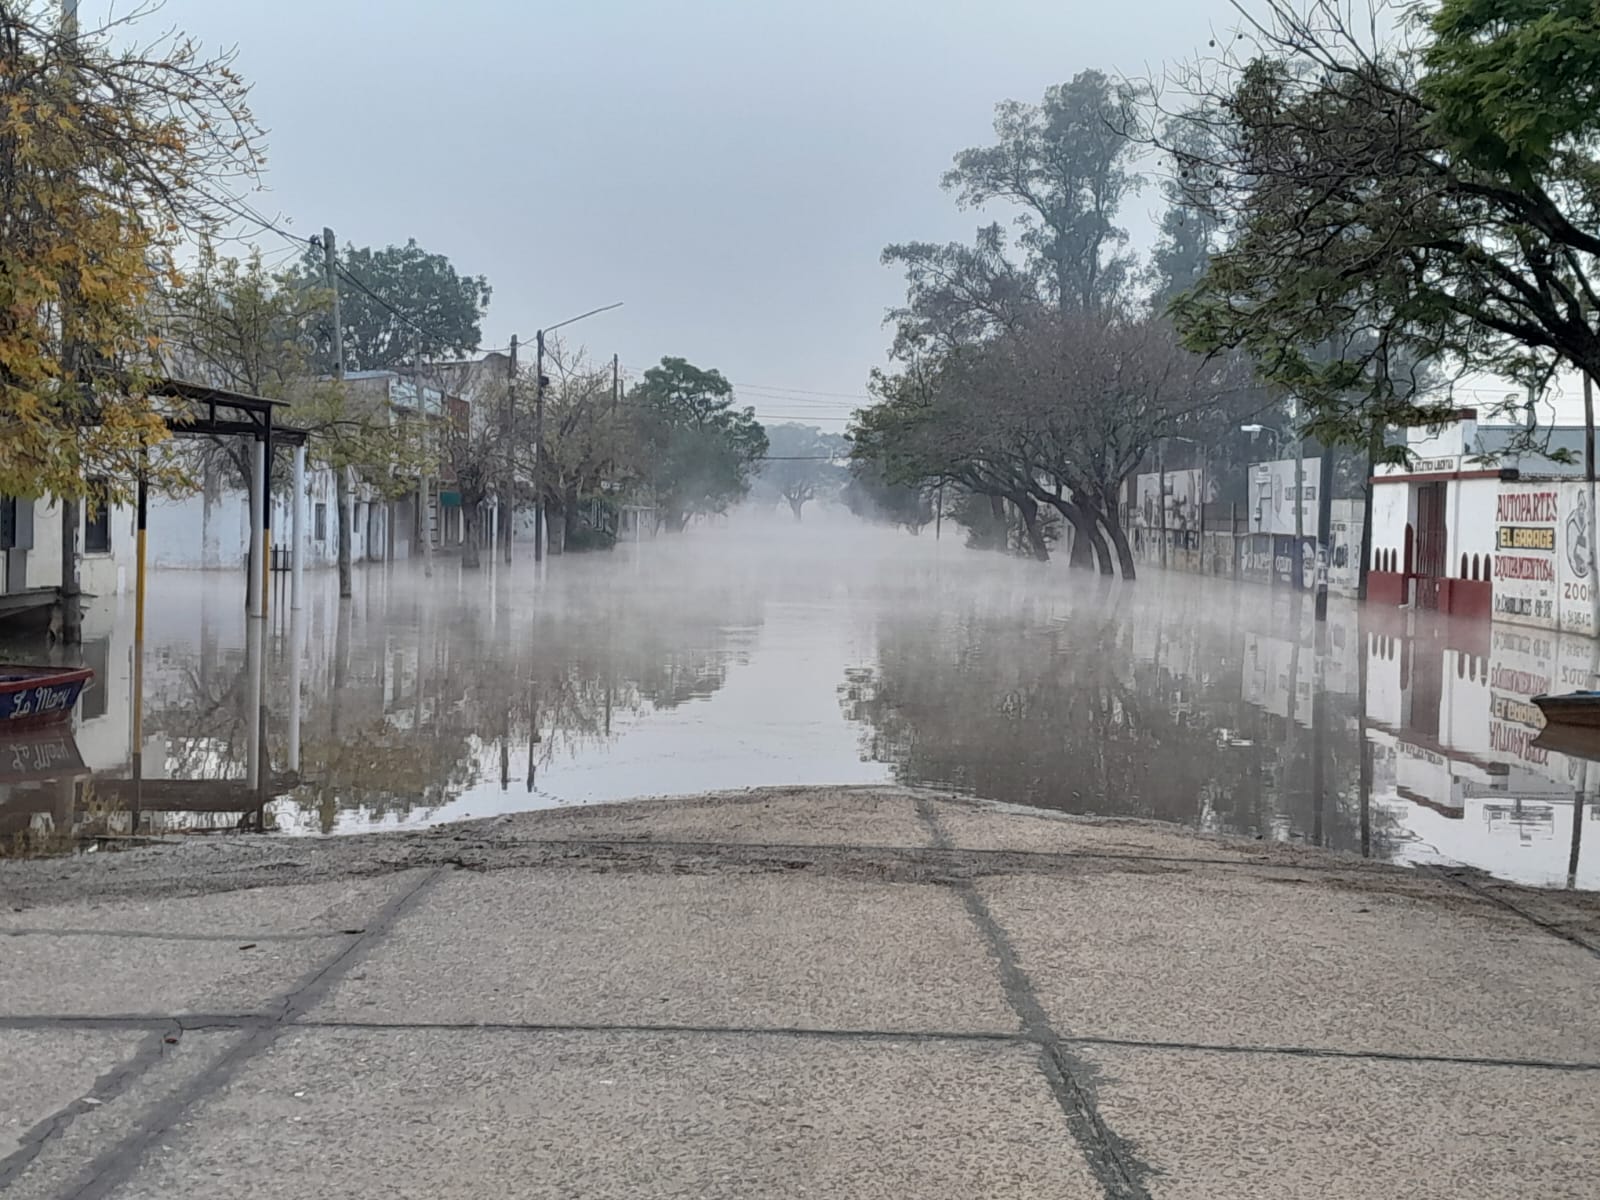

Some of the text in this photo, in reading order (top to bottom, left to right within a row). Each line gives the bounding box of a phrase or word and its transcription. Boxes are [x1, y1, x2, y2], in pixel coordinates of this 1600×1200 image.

[1496, 493, 1558, 522] AUTOPARTES
[1501, 527, 1554, 549] EL GARAGE
